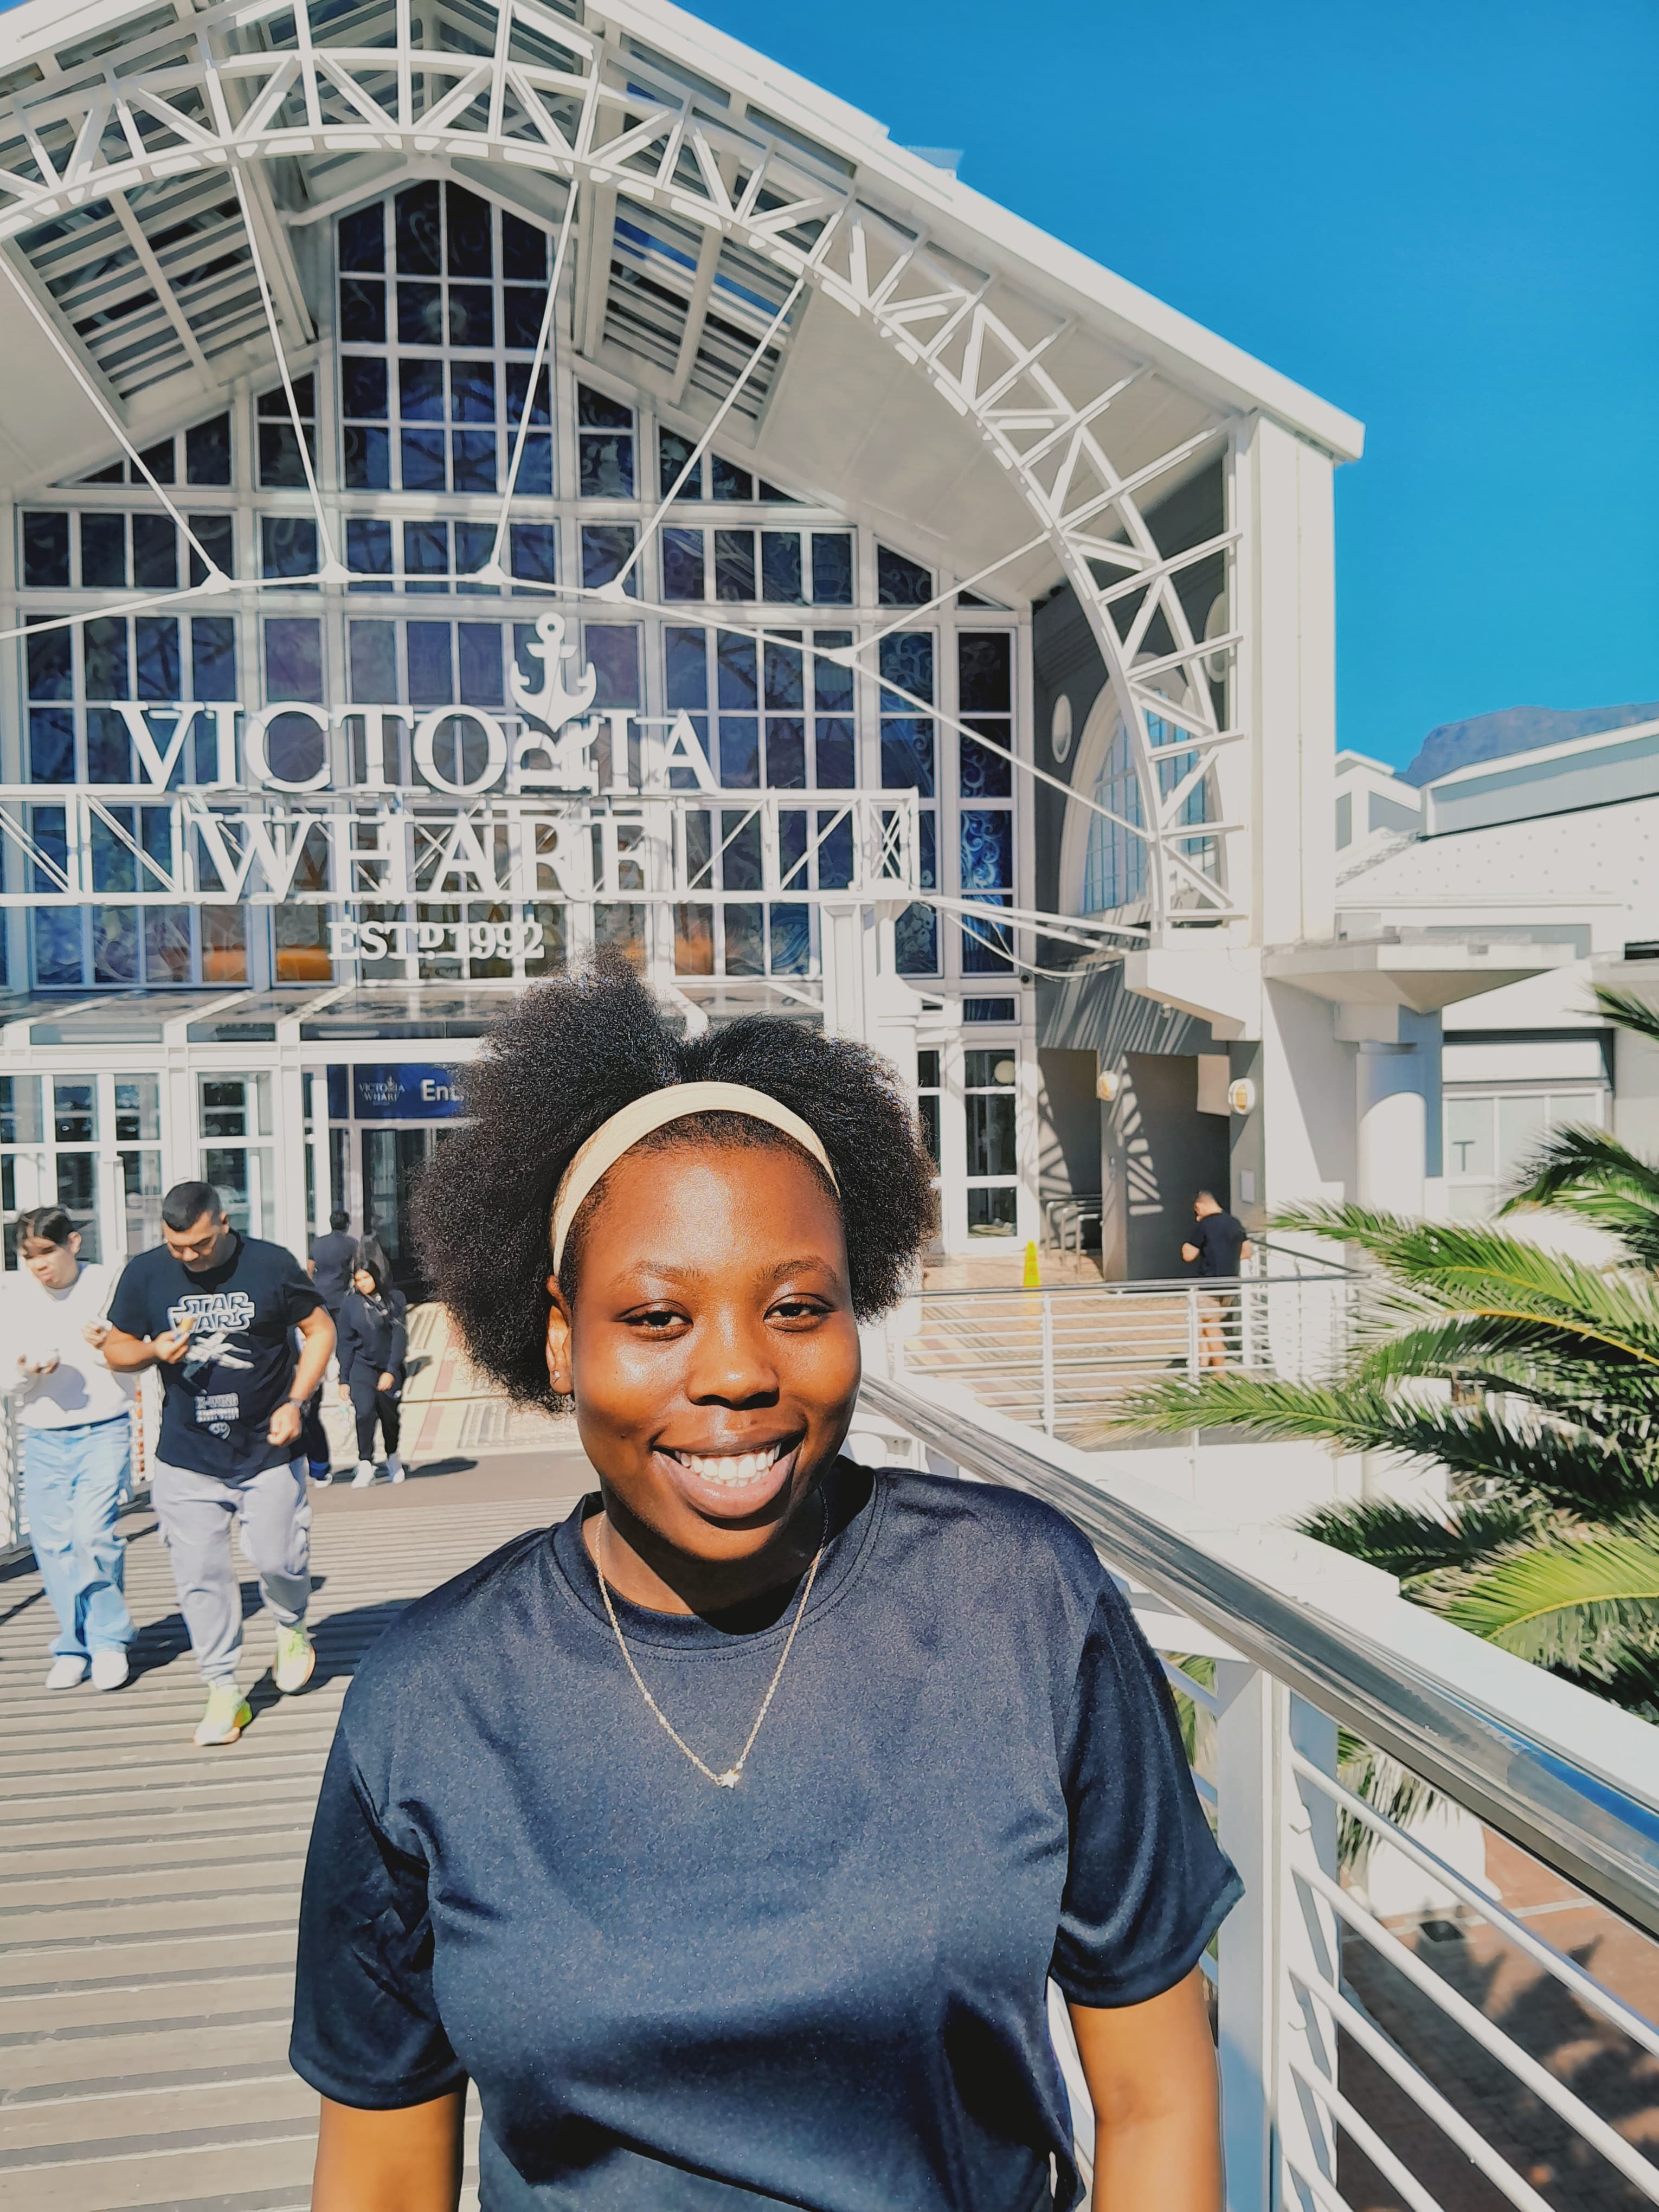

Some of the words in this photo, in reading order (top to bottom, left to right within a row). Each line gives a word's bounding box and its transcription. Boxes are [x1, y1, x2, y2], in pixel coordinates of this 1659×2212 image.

[111, 701, 719, 795] VICTORIA
[190, 812, 647, 904] WHARF
[448, 921, 544, 960] 1992
[168, 1291, 255, 1314] STAR
